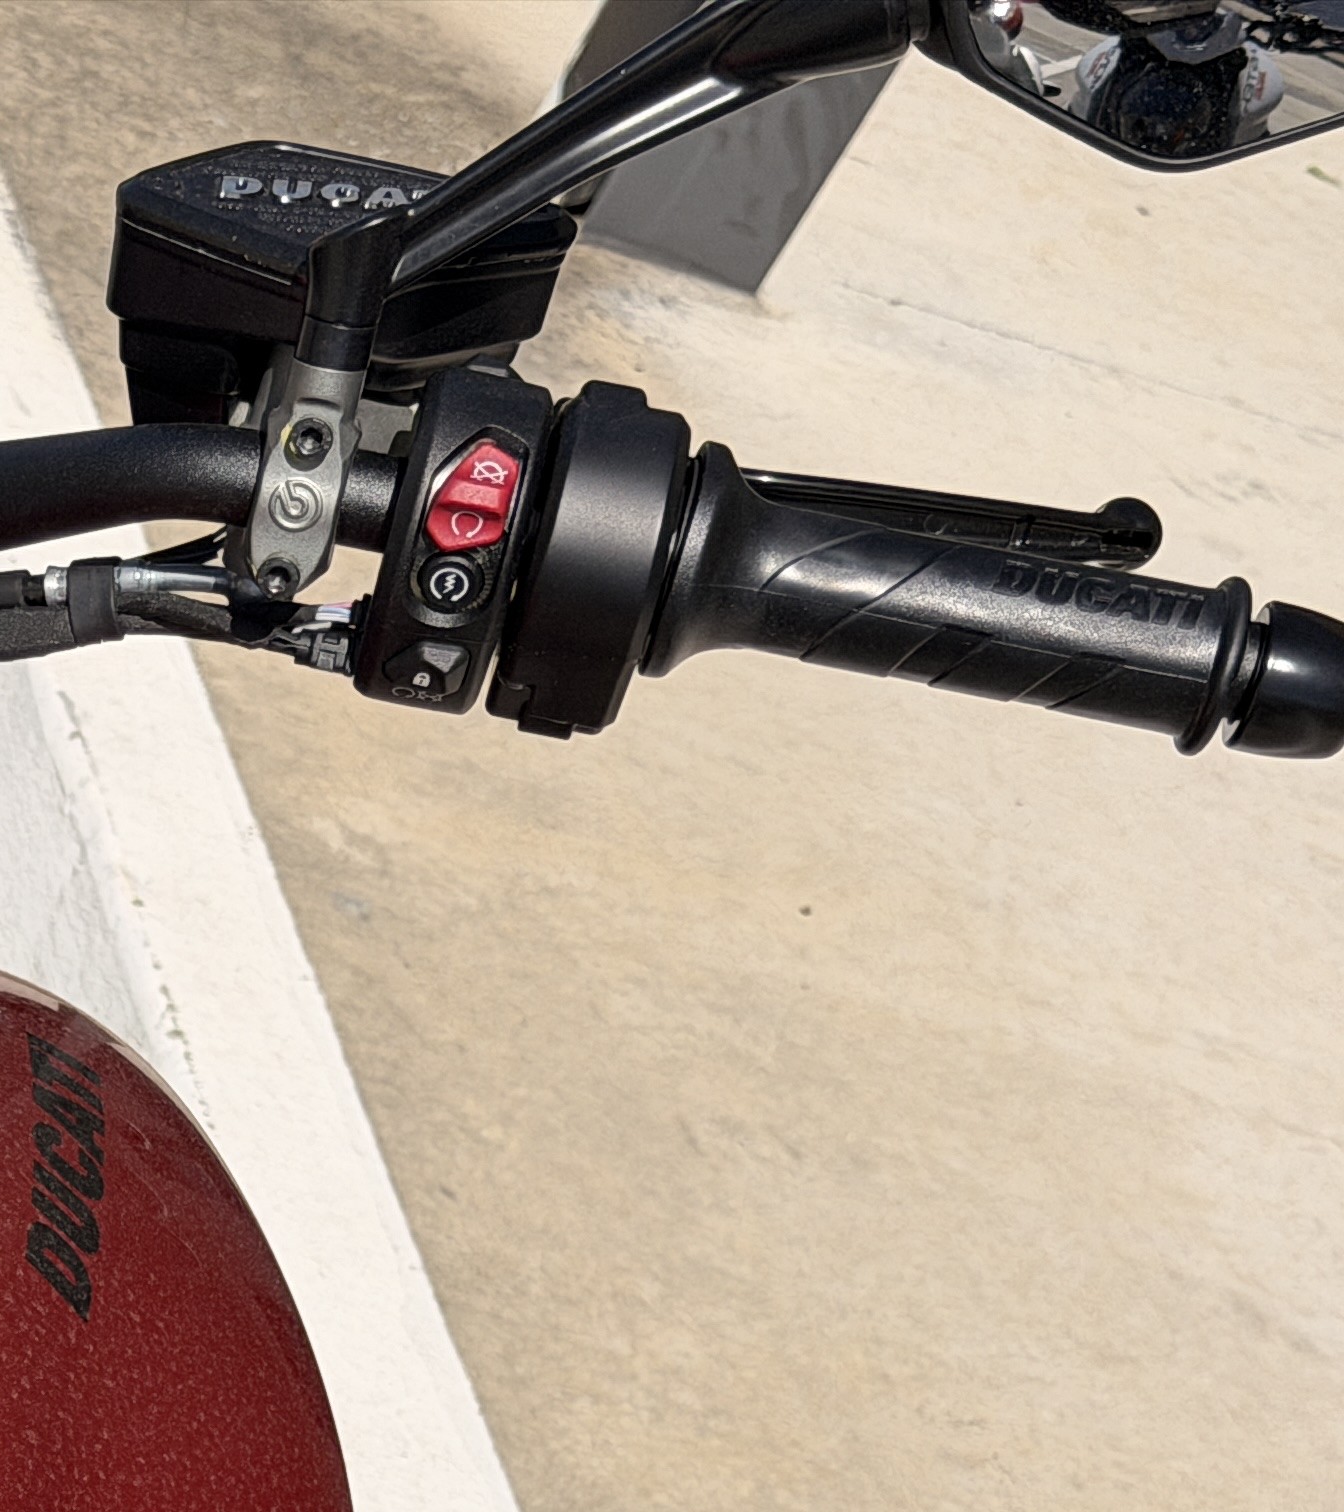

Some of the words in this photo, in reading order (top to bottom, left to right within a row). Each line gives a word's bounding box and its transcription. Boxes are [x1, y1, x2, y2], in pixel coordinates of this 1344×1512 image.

[219, 174, 428, 210] DUCA
[991, 559, 1205, 631] DUCATI
[25, 1032, 105, 1322] DUCATI
